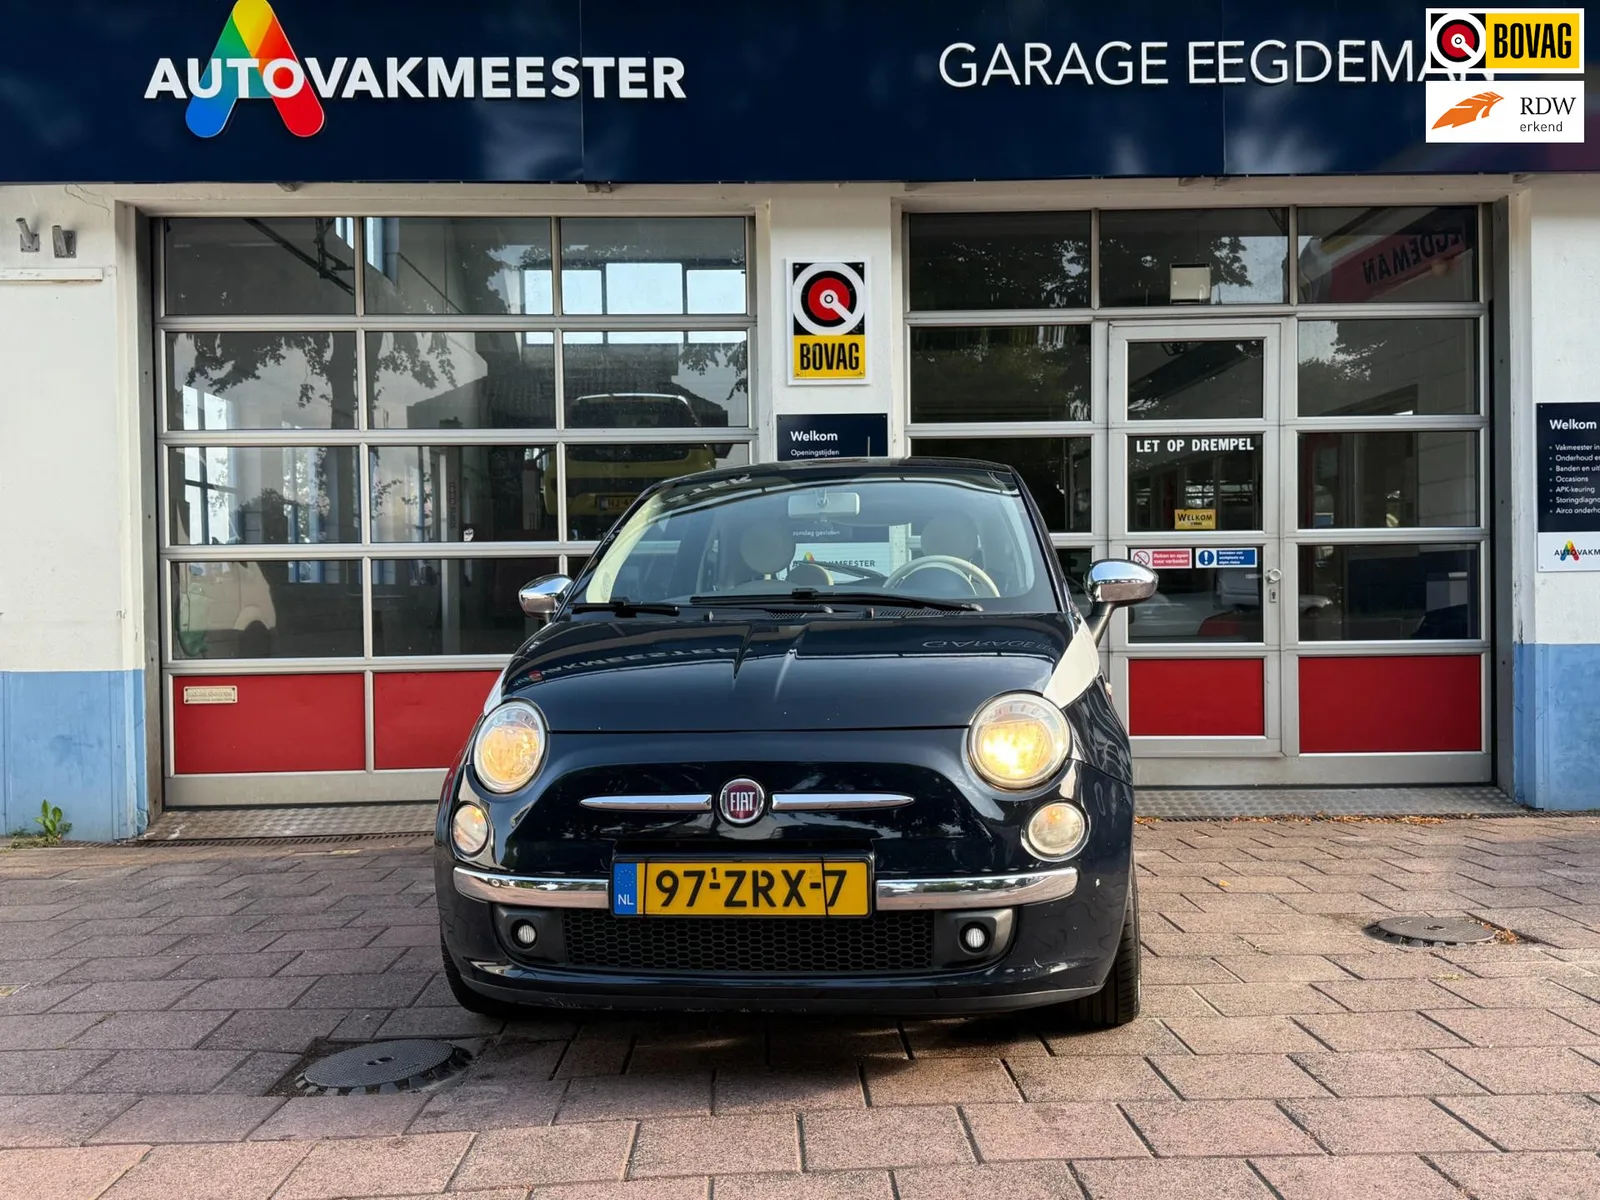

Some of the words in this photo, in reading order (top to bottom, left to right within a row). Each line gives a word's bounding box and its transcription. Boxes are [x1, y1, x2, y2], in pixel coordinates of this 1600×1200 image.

[938, 41, 1169, 87] GARAGE
[1188, 39, 1495, 83] EEGDEM
[144, 57, 687, 99] AUTOVAKMEESTER
[800, 342, 860, 371] BOVAG
[1549, 419, 1597, 430] Welkom
[790, 430, 838, 442] Welkom
[1136, 440, 1160, 453] LET
[1167, 439, 1185, 452] OP
[1192, 438, 1254, 451] DREMPEL
[790, 449, 840, 457] Openingstijden
[1555, 454, 1594, 462] Onderhoud
[1555, 475, 1589, 483] Occasions
[1555, 486, 1596, 494] APK-keuring
[730, 791, 756, 812] FIAT
[655, 869, 848, 908] 97-ZRX-7
[617, 893, 634, 906] NL
